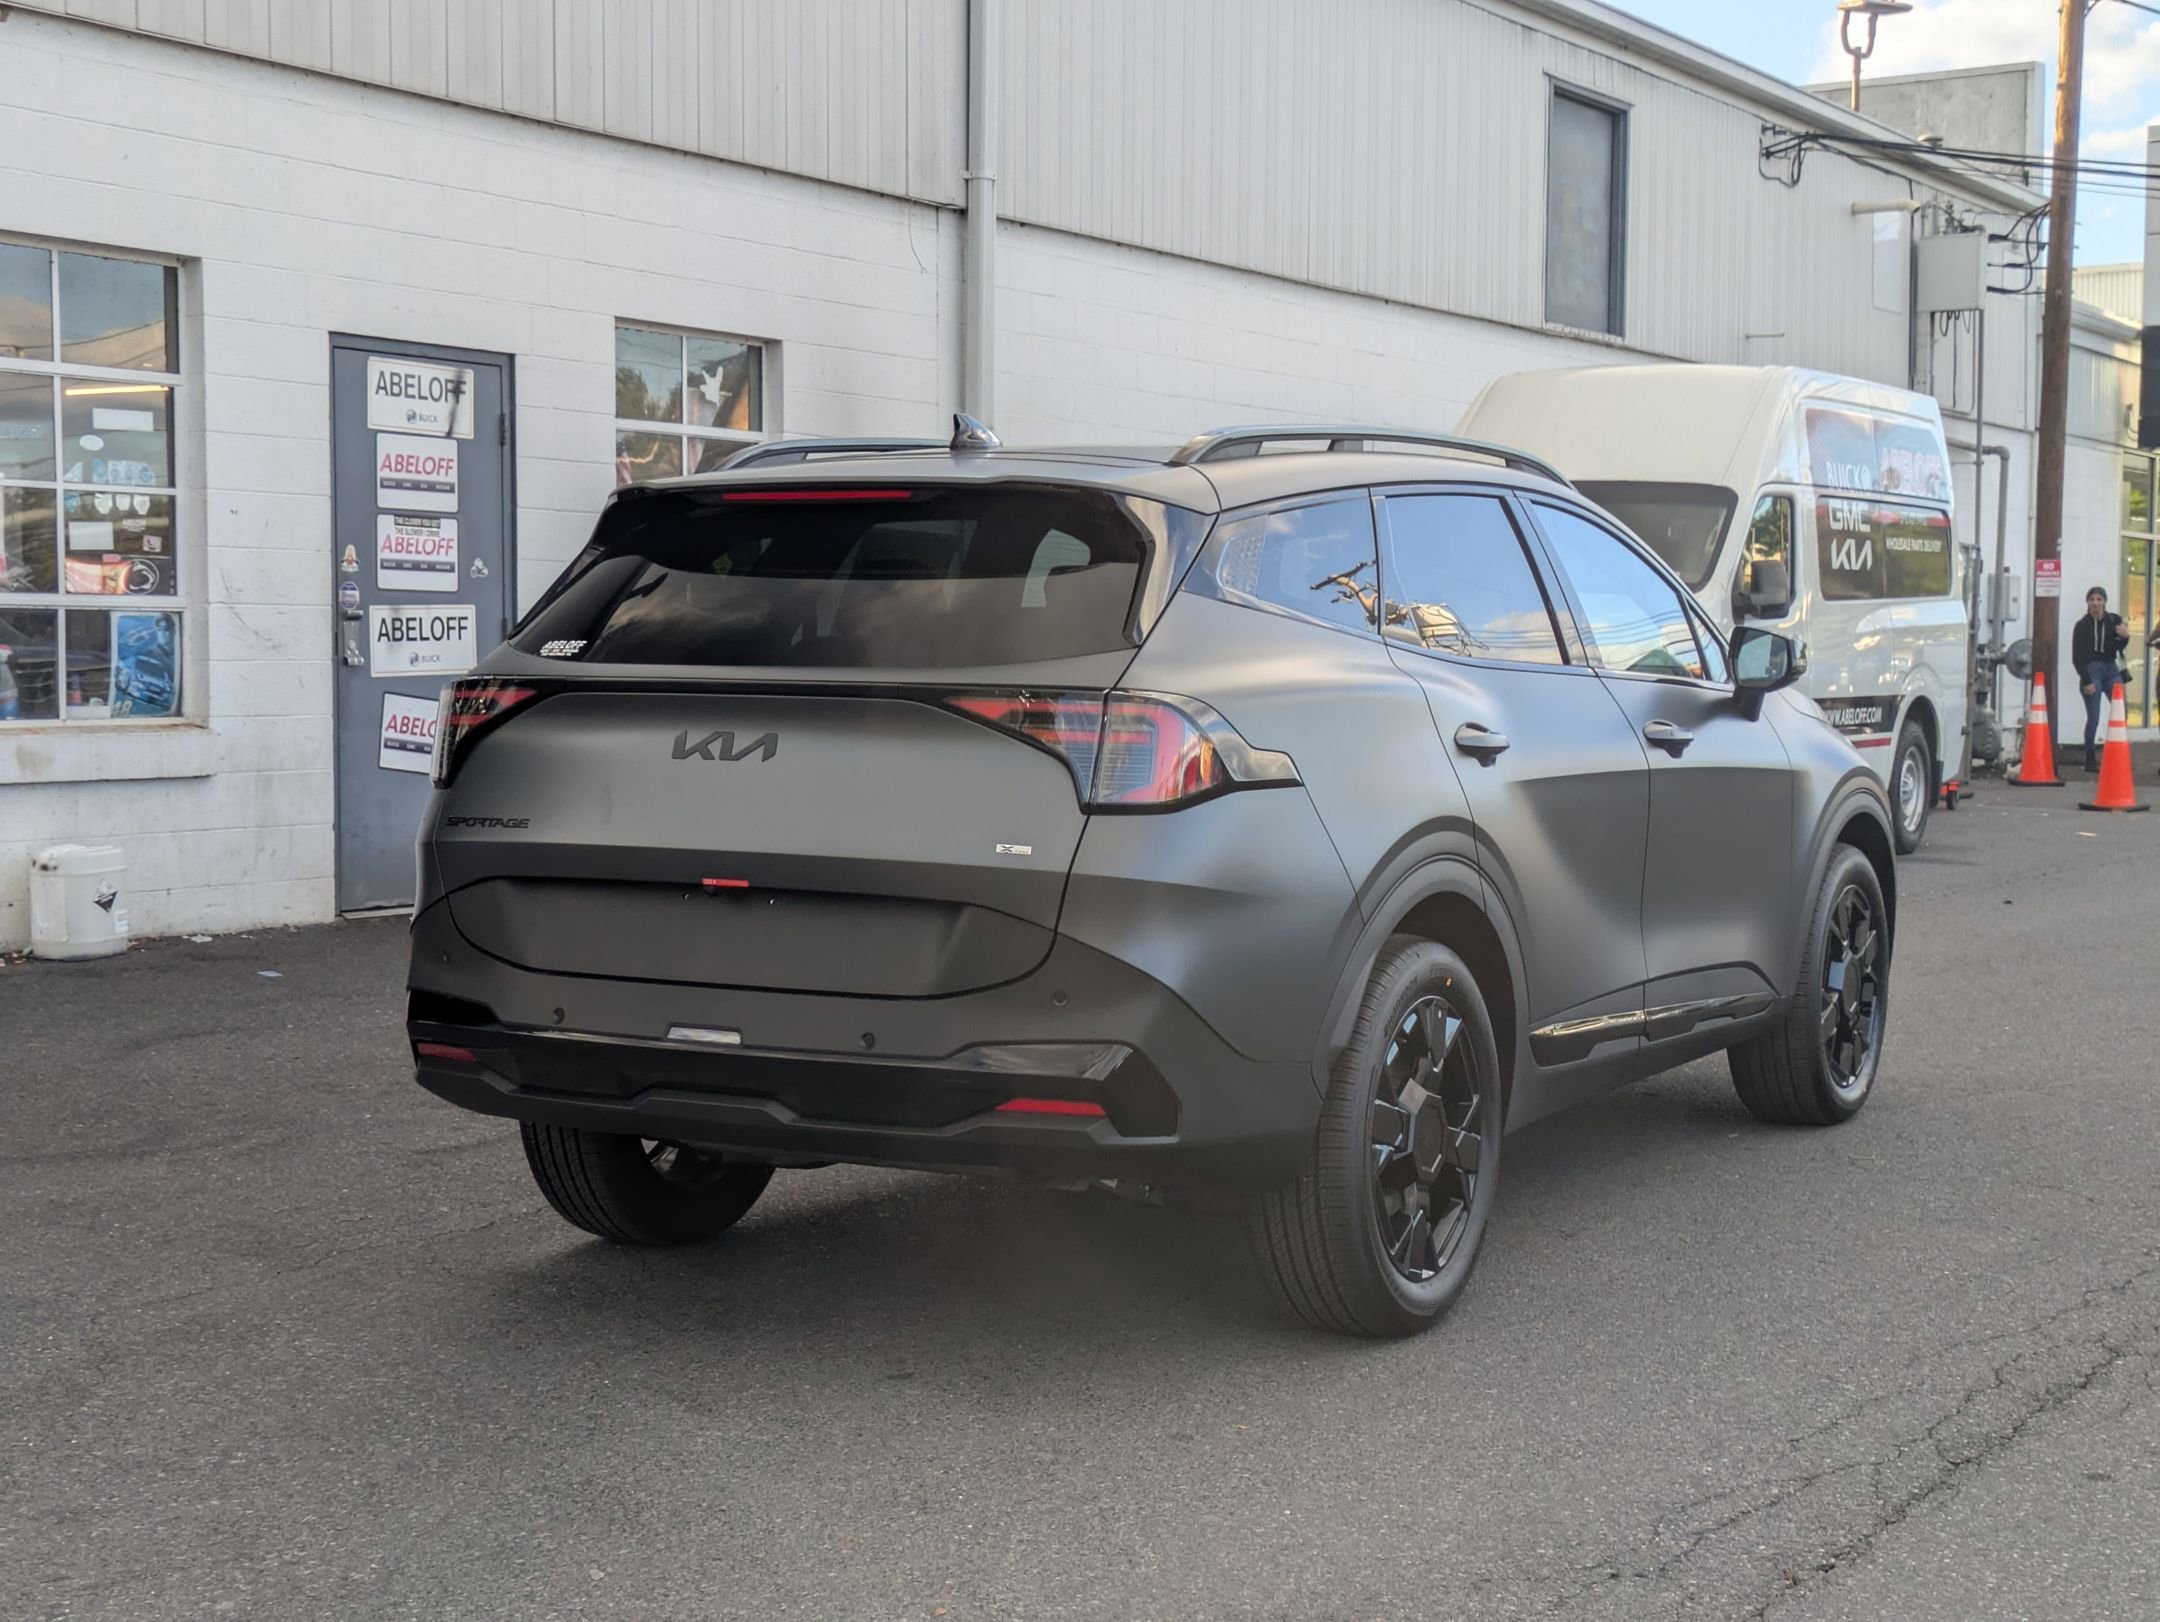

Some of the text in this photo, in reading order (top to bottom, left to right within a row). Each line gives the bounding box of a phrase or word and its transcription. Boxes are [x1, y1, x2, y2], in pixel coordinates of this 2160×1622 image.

[375, 370, 467, 405] ABELOFF
[380, 453, 455, 478] ABELOFF
[1828, 500, 1872, 533] GMC
[381, 534, 455, 556] ABELOFF
[377, 616, 469, 643] ABELOFF
[446, 816, 531, 829] SPORTAGE
